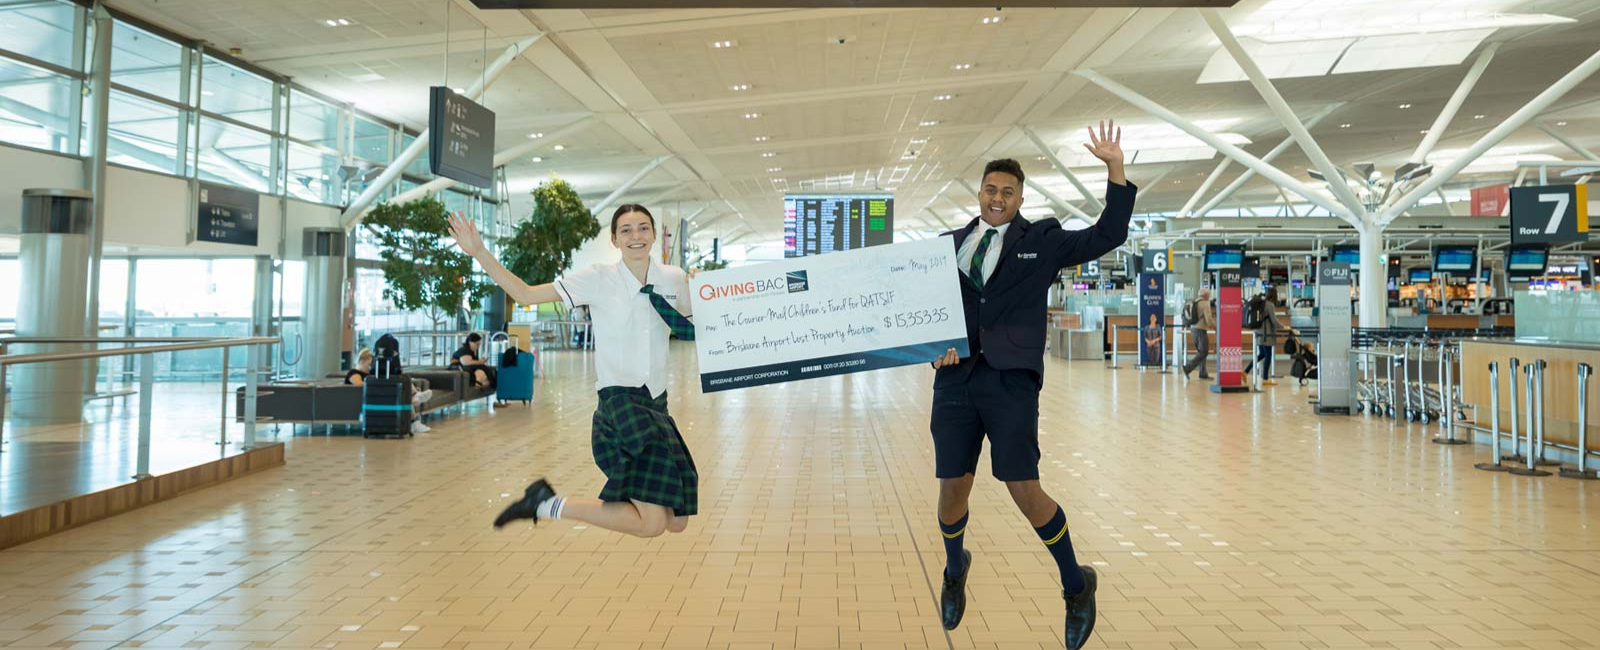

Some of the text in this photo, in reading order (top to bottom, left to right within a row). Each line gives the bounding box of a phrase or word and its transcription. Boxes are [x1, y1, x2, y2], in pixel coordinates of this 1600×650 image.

[1519, 193, 1570, 235] Row 7
[1088, 260, 1099, 276] 5
[1153, 251, 1167, 271] 6
[1331, 268, 1348, 276] FIJI
[699, 282, 755, 301] GIVING
[756, 276, 784, 293] BAC
[720, 313, 735, 327] The
[828, 298, 847, 313] Fund
[848, 297, 859, 309] for
[860, 290, 895, 308] QATSIF
[726, 340, 760, 354] Brisbane
[763, 335, 791, 351] Airport
[791, 331, 808, 344] Lost
[810, 327, 845, 345] Property
[847, 323, 875, 336] Auction
[709, 369, 789, 385] BRISBANE AIRPORT CORPORATION
